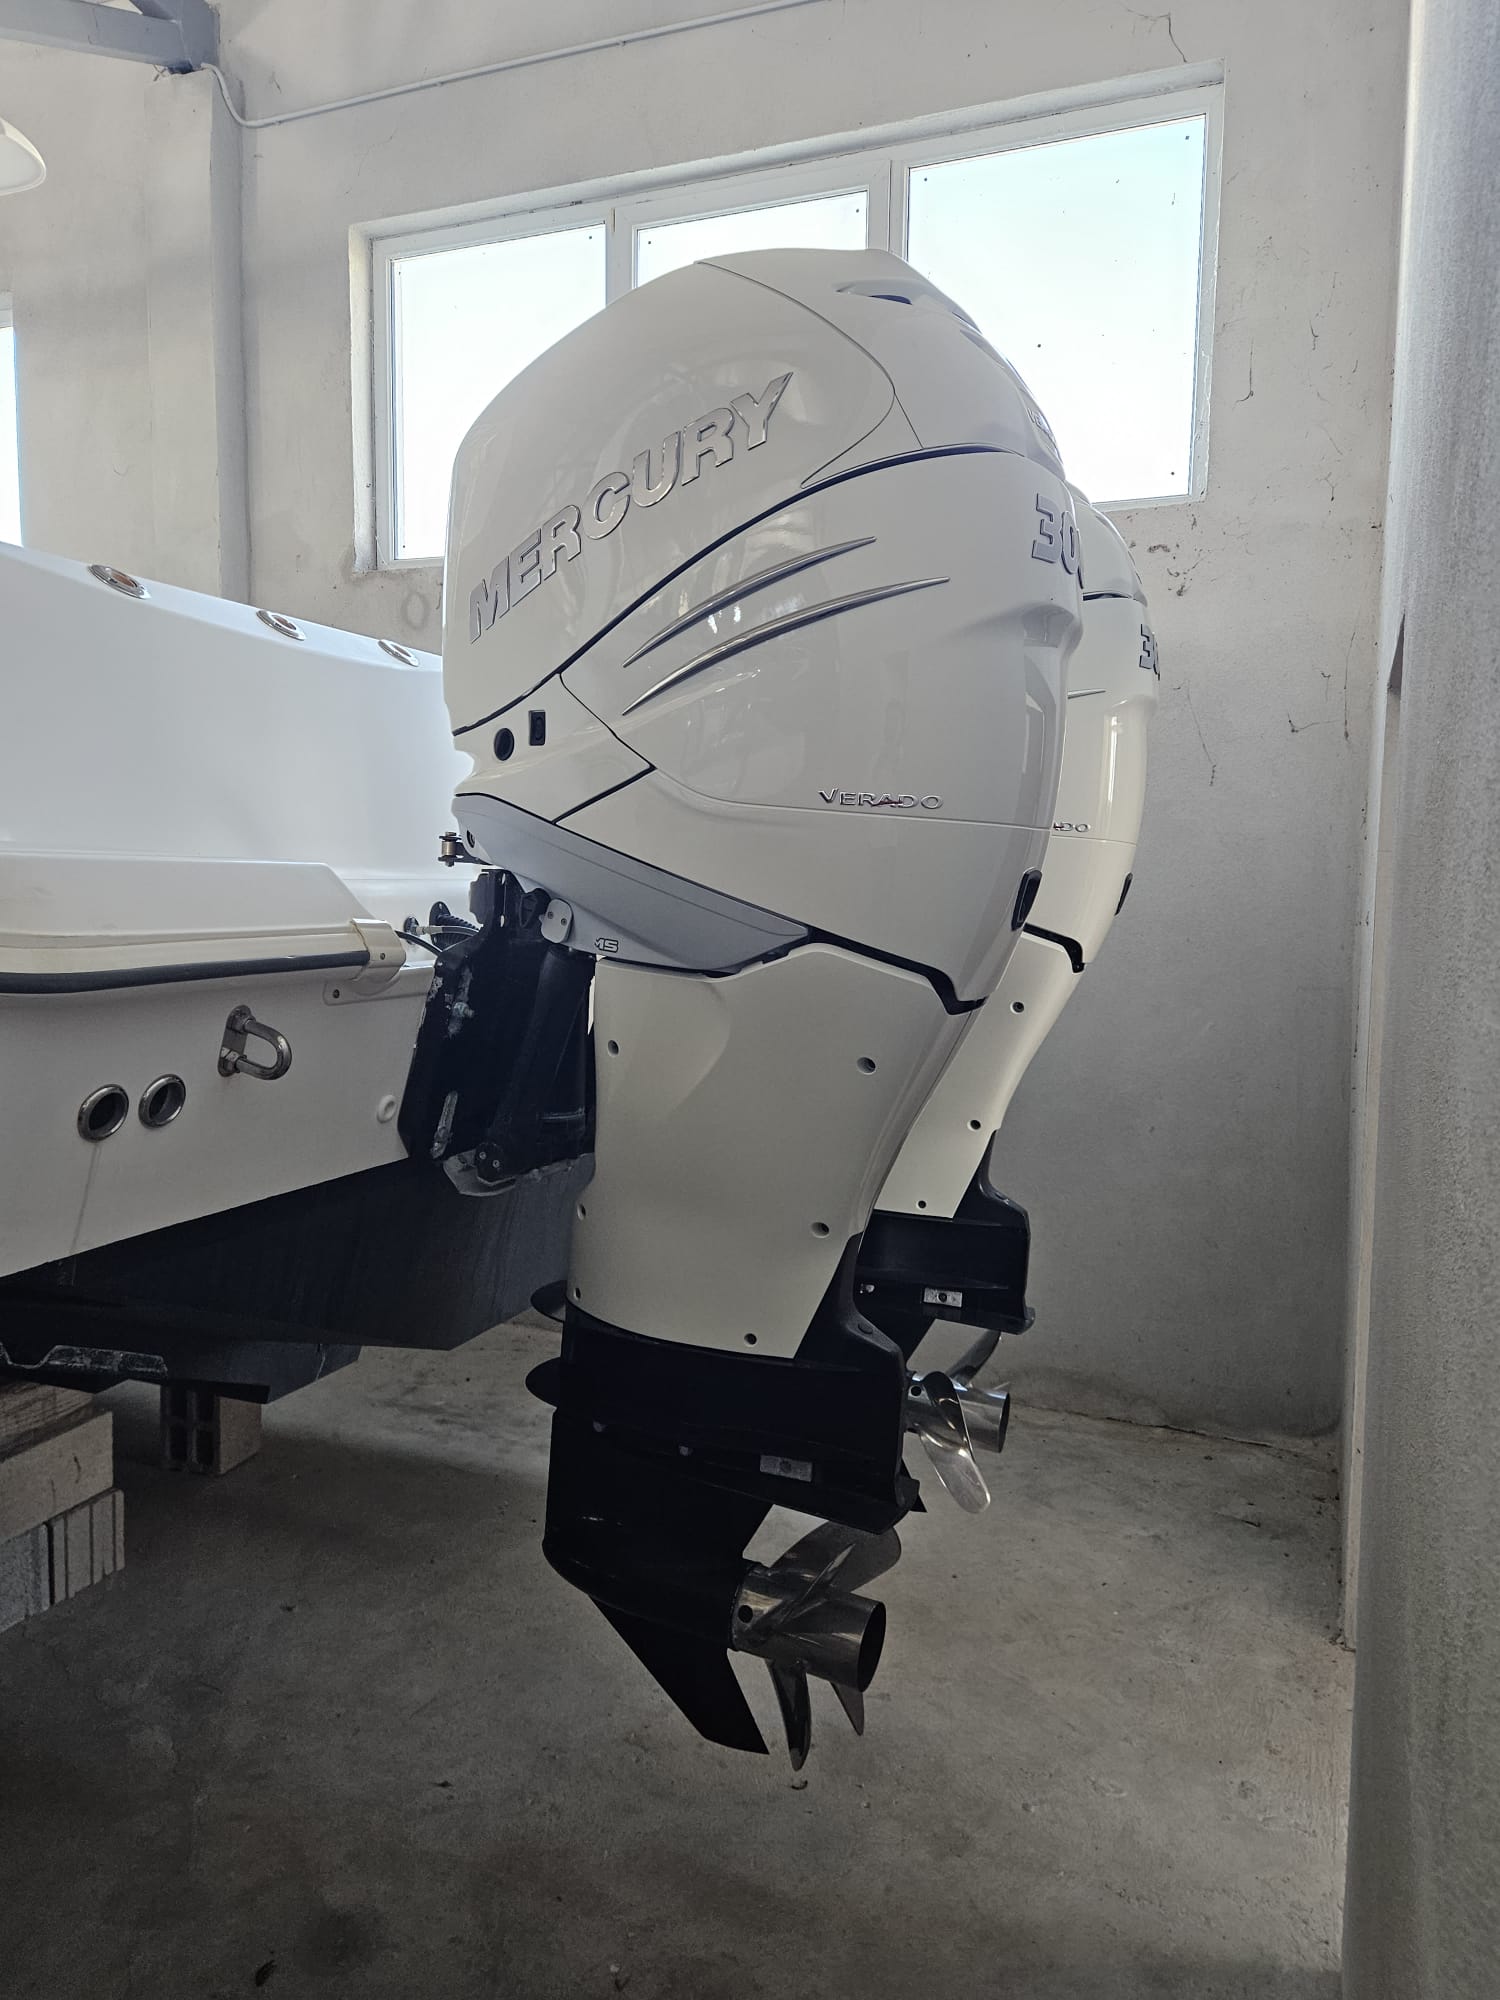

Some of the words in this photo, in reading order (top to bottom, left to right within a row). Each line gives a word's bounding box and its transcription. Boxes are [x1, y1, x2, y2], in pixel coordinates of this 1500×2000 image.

[468, 371, 795, 645] MERCURY
[1031, 491, 1083, 589] 30
[818, 787, 944, 810] VERADO
